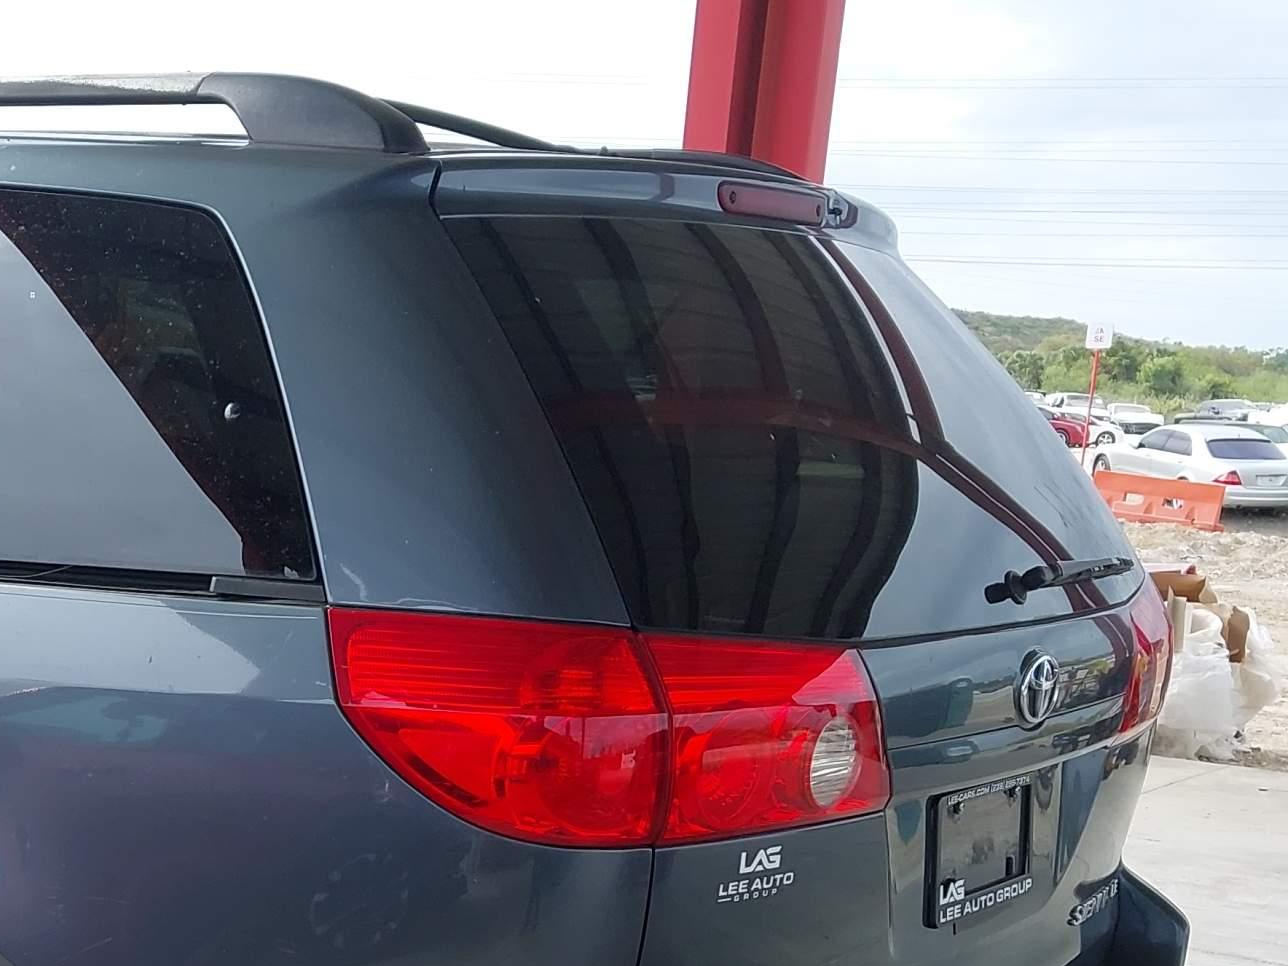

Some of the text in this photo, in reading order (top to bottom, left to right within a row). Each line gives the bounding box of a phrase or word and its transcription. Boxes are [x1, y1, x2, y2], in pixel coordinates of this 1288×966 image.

[739, 845, 782, 874] LAG
[718, 872, 794, 897] LEE AUTO
[733, 888, 778, 902] GROUP
[939, 879, 966, 905] LAG
[940, 878, 1032, 923] LEE AUTO GROUP
